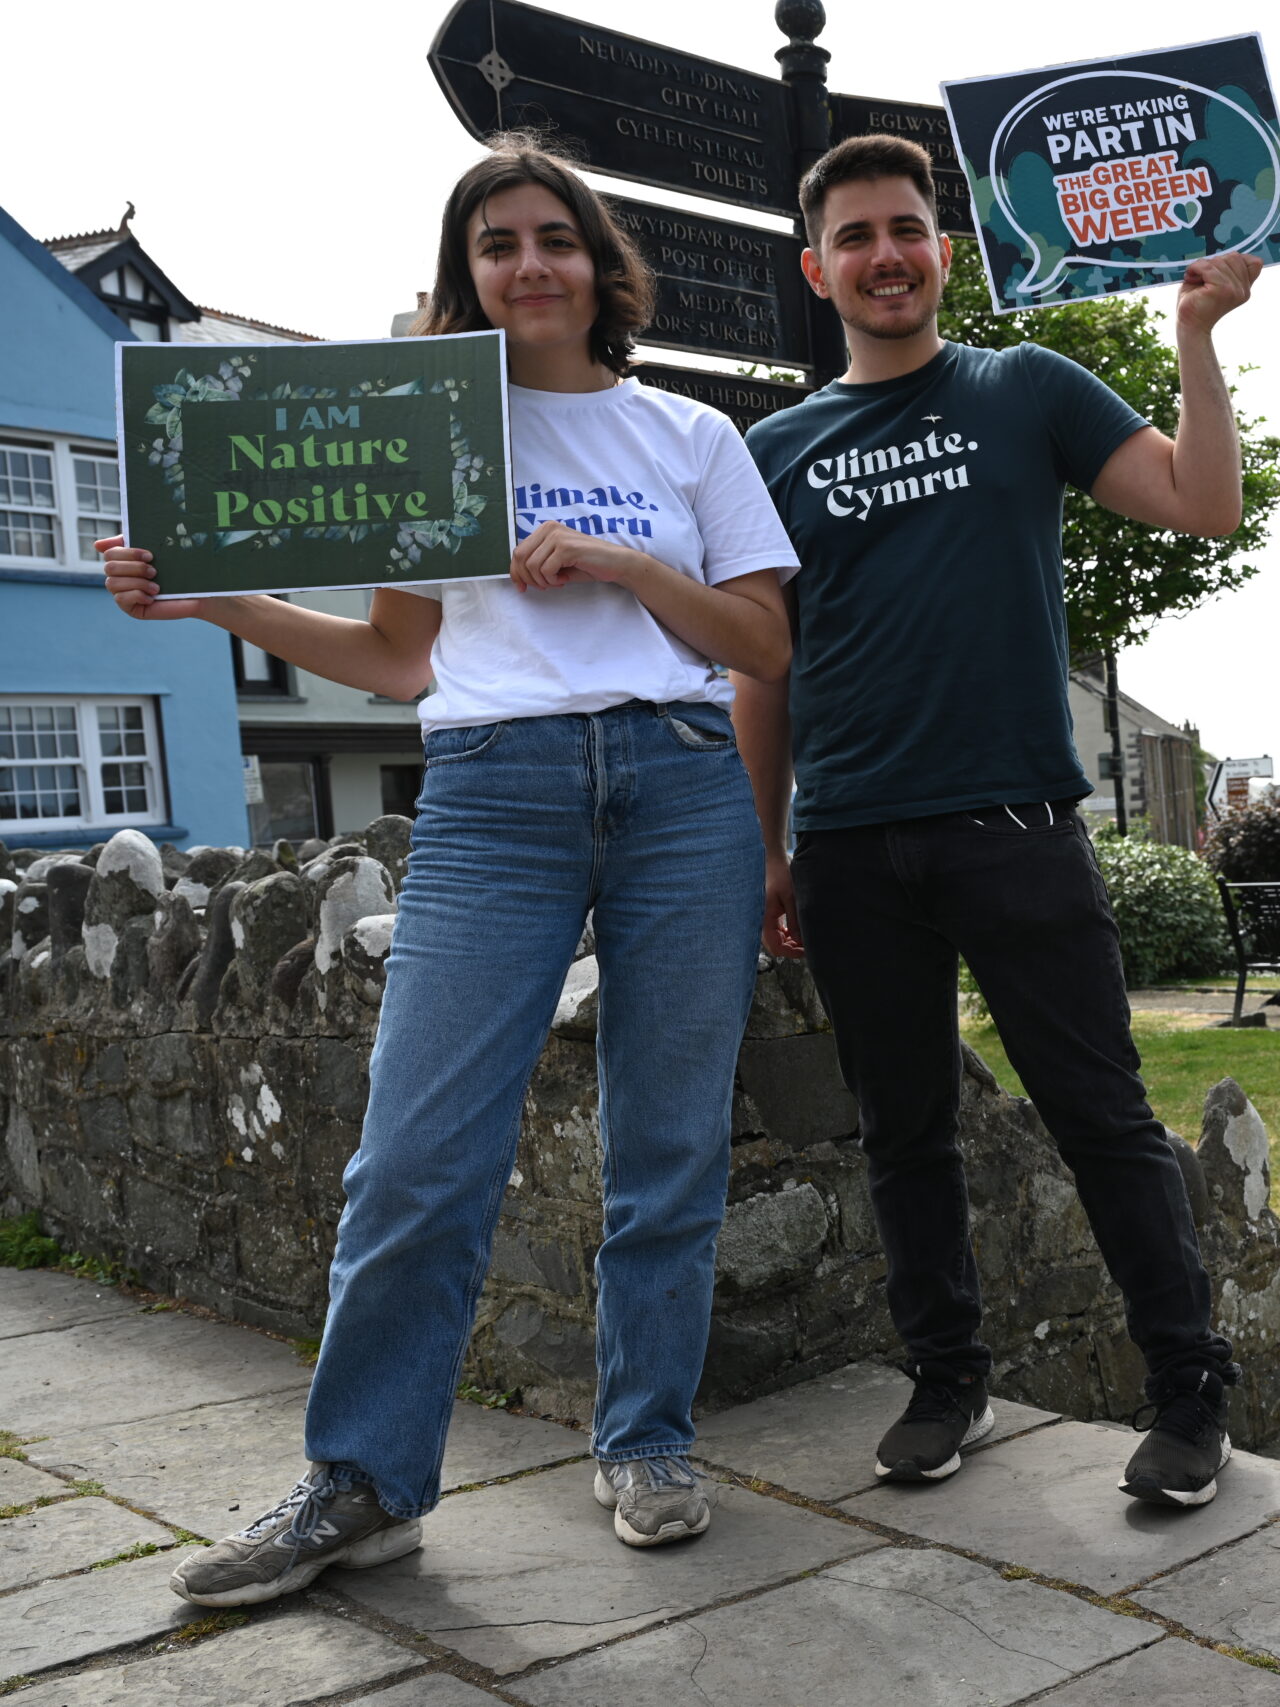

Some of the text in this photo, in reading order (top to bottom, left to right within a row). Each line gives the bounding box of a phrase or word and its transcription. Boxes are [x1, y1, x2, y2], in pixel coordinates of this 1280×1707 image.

[579, 36, 667, 75] NEUADD
[690, 68, 761, 104] DDINAS
[661, 87, 759, 128] CITY HALL
[869, 111, 948, 135] EGLWYS
[1042, 94, 1189, 132] WE'RE TAKING
[616, 117, 765, 169] CYFLEUSTERAU
[1046, 113, 1196, 164] PART IN
[691, 160, 768, 194] TOILETS
[1057, 155, 1176, 193] THE GREAT
[1060, 171, 1209, 216] BIG GREEN
[1066, 202, 1177, 243] WEEK
[661, 246, 775, 284] POST OFFICE
[729, 235, 773, 259] POST
[679, 291, 778, 324] MEDDYGFA
[699, 320, 779, 348] SURGERY
[642, 376, 786, 412] ORSAF HEDDLU
[275, 405, 361, 432] I AM
[228, 432, 410, 471] Nature
[806, 430, 979, 490] Climate.
[214, 482, 429, 528] Positive
[514, 483, 660, 512] limate.
[826, 464, 972, 522] Cymru
